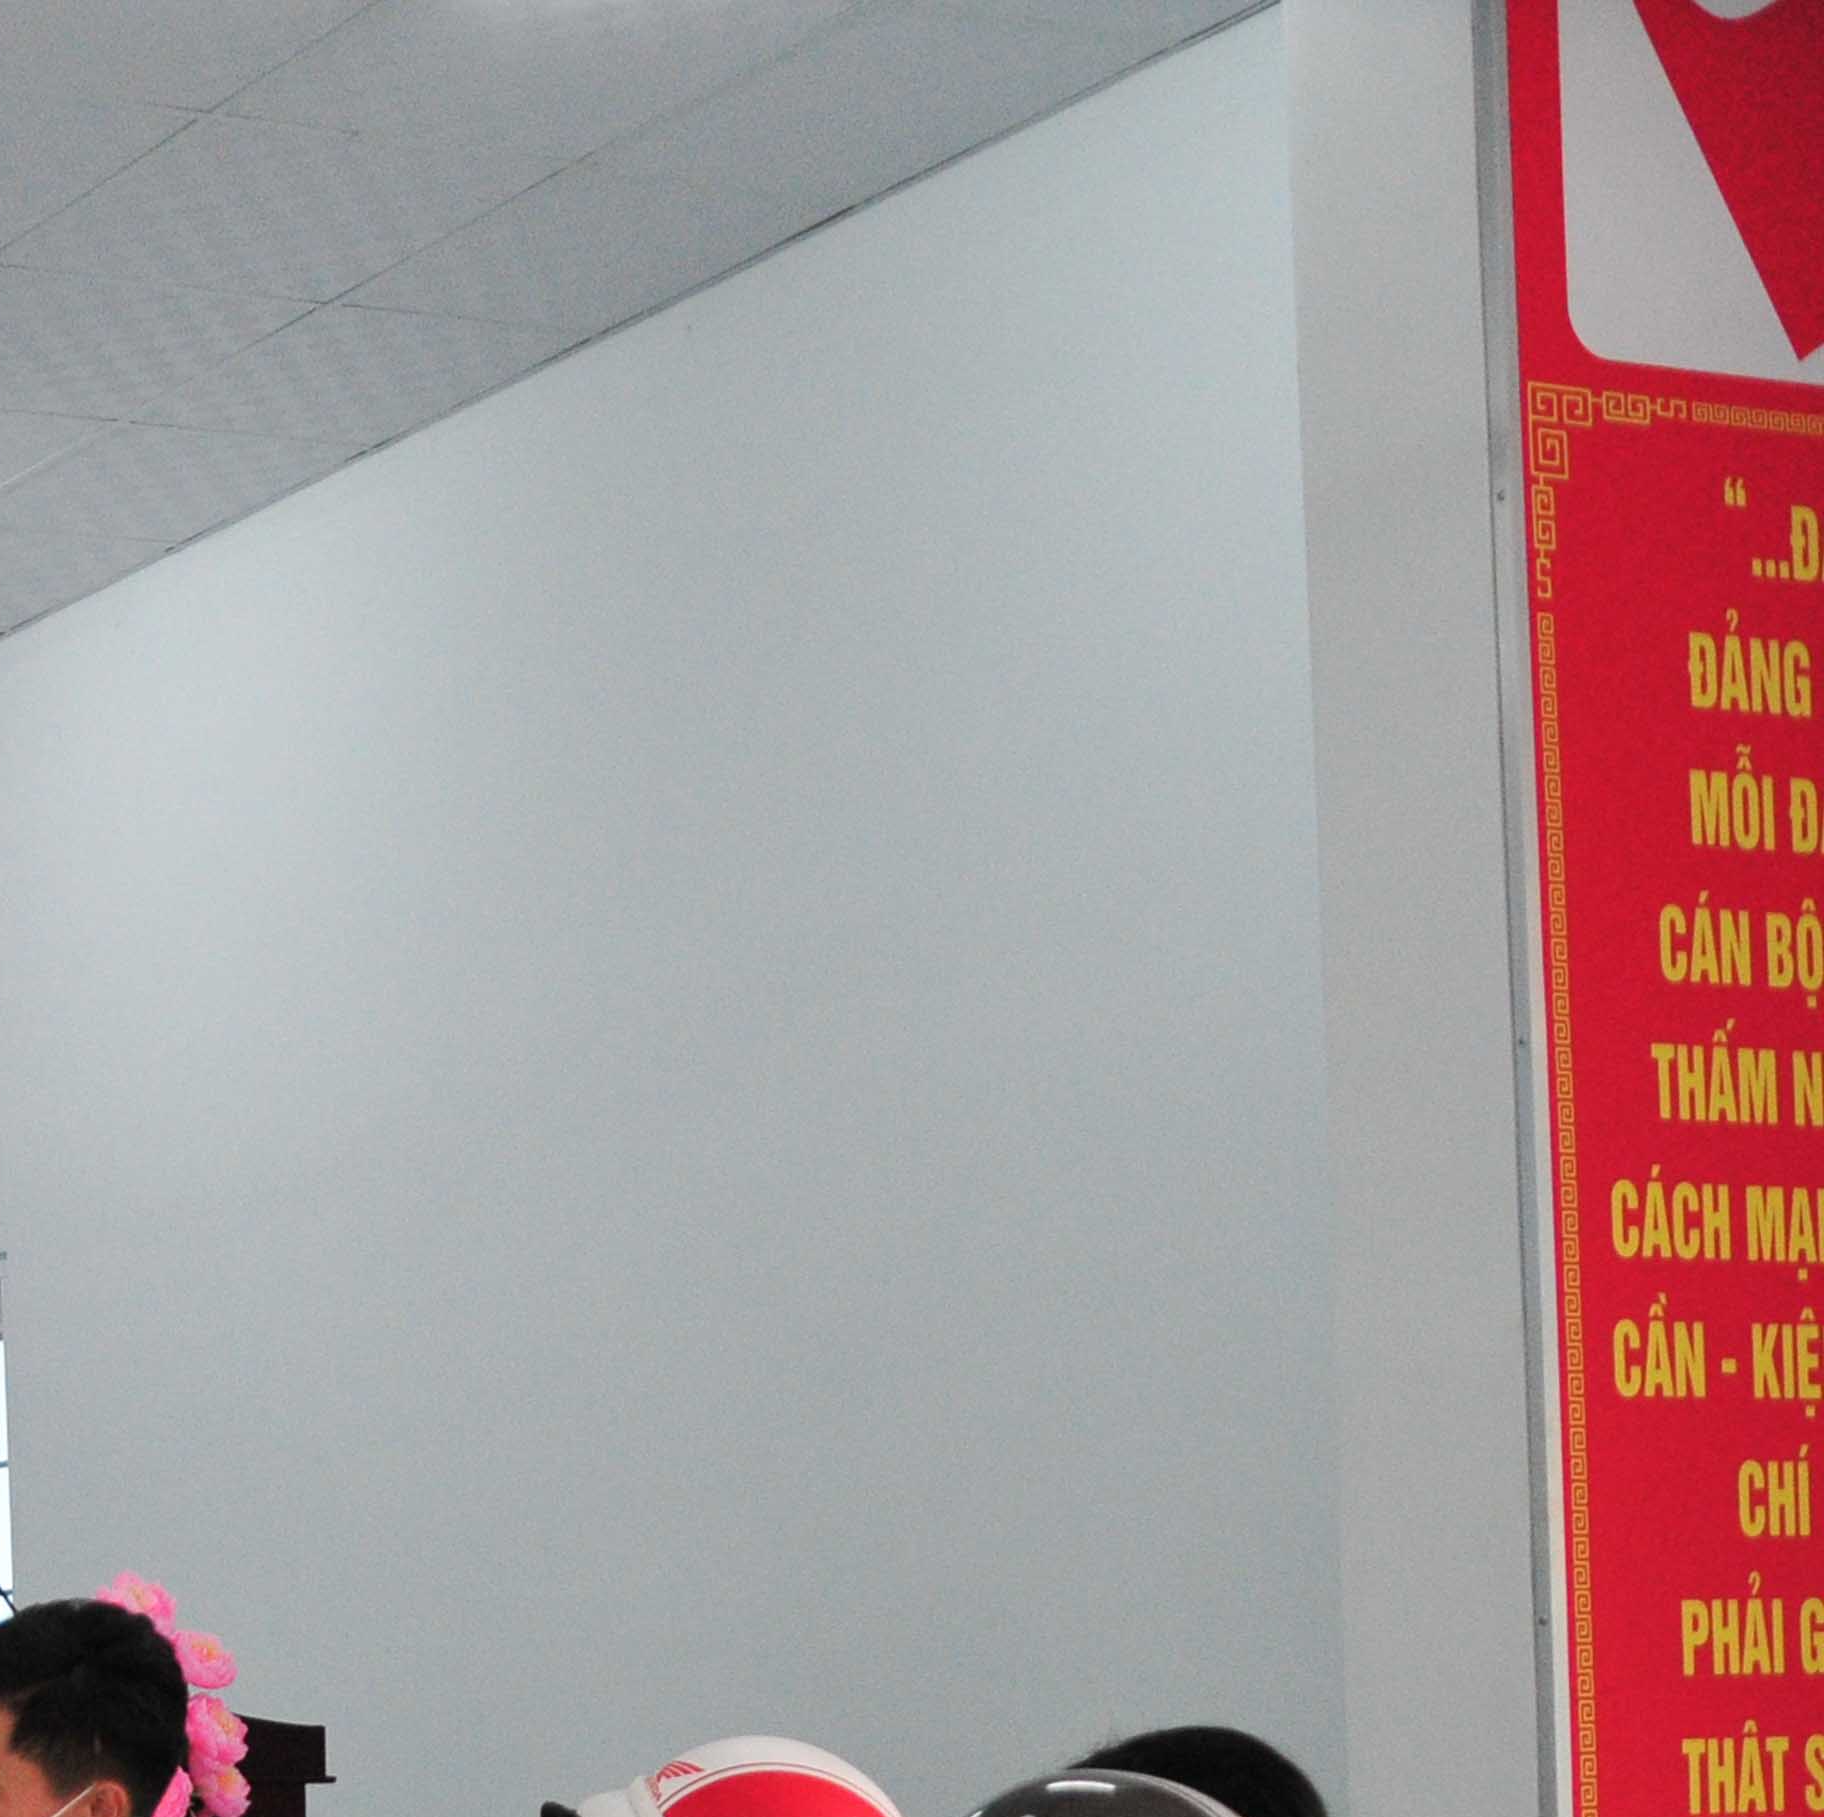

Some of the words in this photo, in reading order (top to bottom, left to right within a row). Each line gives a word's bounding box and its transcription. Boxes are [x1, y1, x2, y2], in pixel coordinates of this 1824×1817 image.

[1688, 609, 1812, 717] ĐẢNG
[1690, 746, 1775, 851] MỖI
[1789, 776, 1824, 854] Đ
[1659, 890, 1752, 986] CÁN
[1766, 898, 1824, 1008] BỘ
[1652, 1019, 1778, 1125] THẤM
[1611, 1165, 1732, 1260] CÁCH
[1746, 1186, 1824, 1281] MẠ
[1613, 1293, 1707, 1398] CẦN
[1738, 1445, 1811, 1538] CHÍ
[1681, 1572, 1785, 1676] PHẢI
